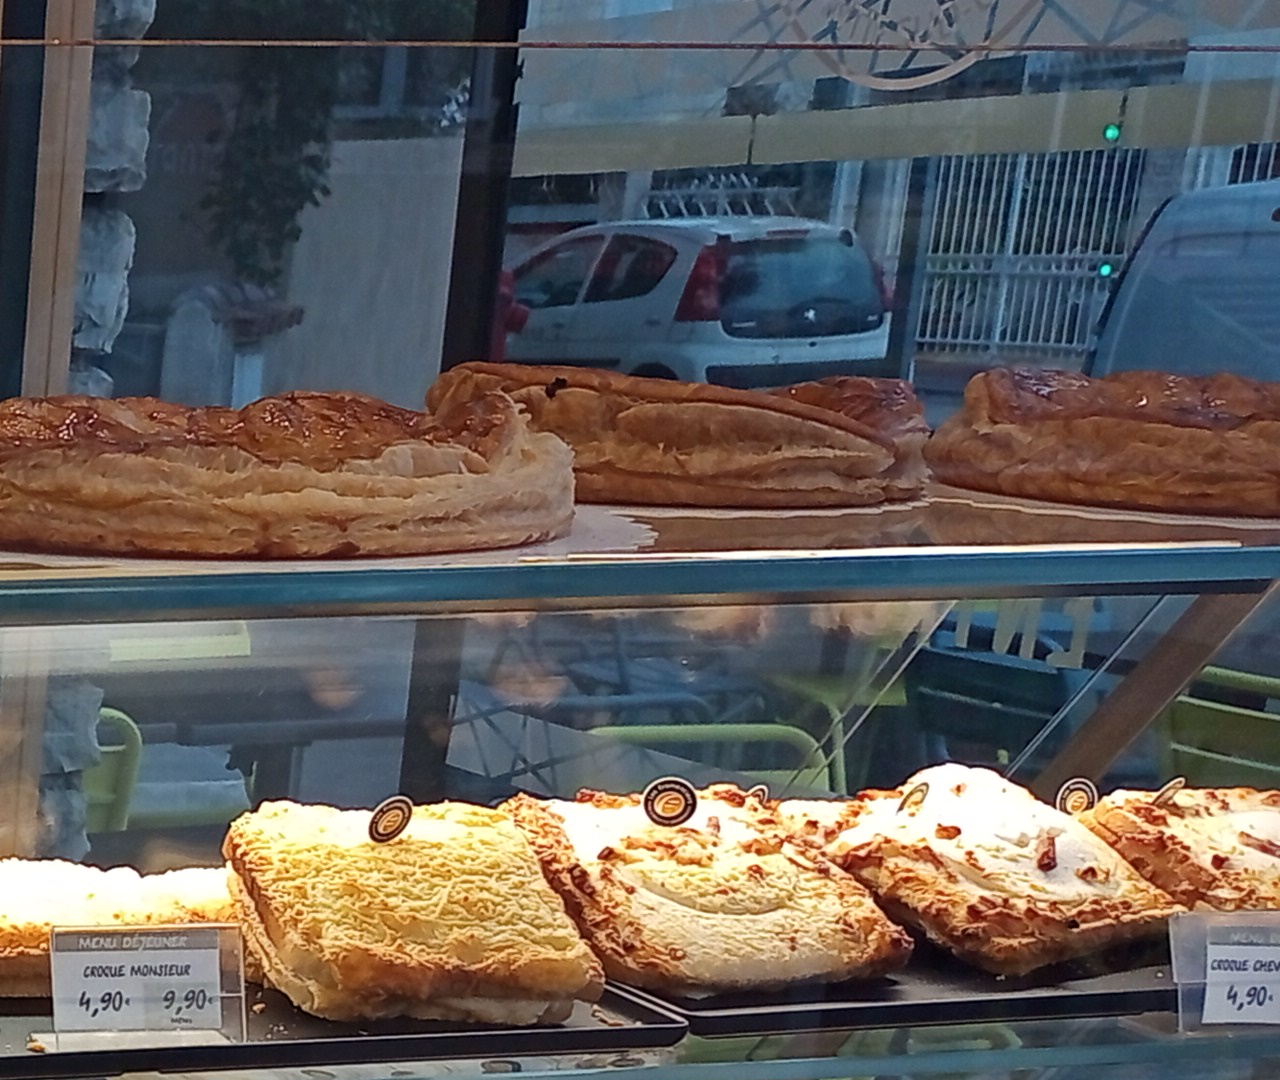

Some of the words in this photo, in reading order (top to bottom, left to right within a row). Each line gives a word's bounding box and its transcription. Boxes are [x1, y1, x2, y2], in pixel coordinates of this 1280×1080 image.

[77, 936, 117, 949] MENU
[122, 934, 189, 951] DÉJEUNER
[83, 964, 125, 978] CROQUE
[130, 964, 191, 977] MONSIEUR
[1210, 959, 1250, 972] CROQUE
